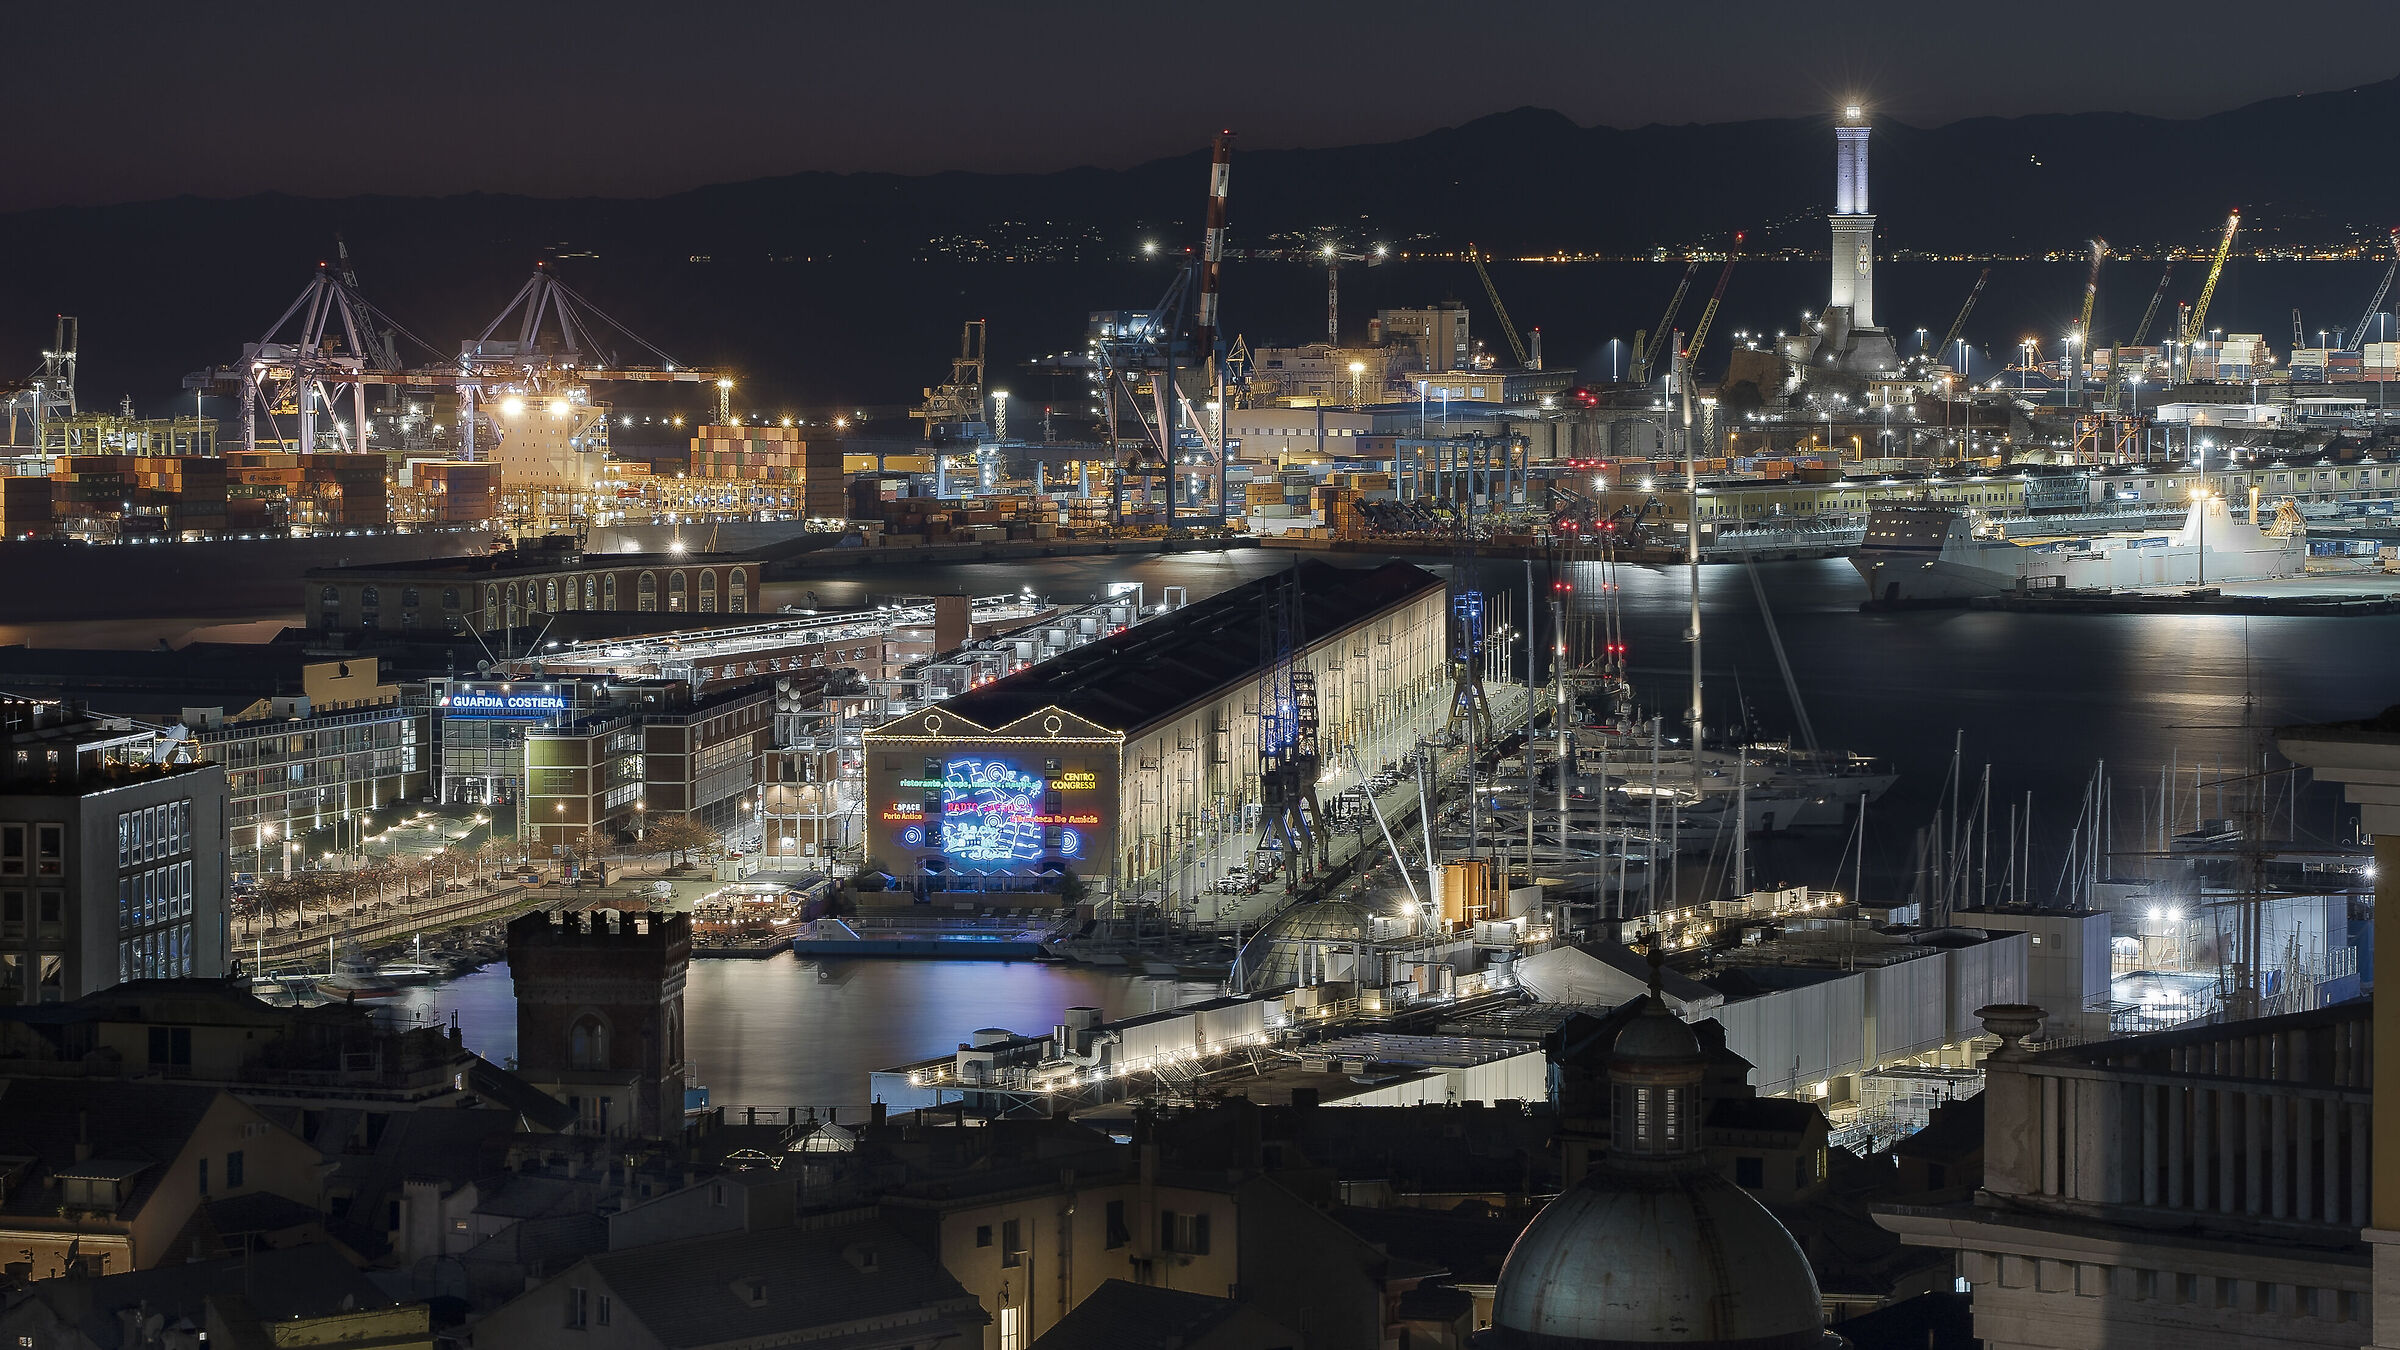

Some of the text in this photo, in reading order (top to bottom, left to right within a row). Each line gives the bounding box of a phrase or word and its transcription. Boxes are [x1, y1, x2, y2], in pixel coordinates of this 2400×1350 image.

[453, 696, 564, 708] GUARDIA COSTIERA
[1064, 773, 1095, 781] CENTRO
[1051, 781, 1096, 790] CONGRESSI
[947, 802, 979, 812] RADIO
[883, 812, 923, 820] Porto Antico
[1068, 815, 1098, 823] Amicis
